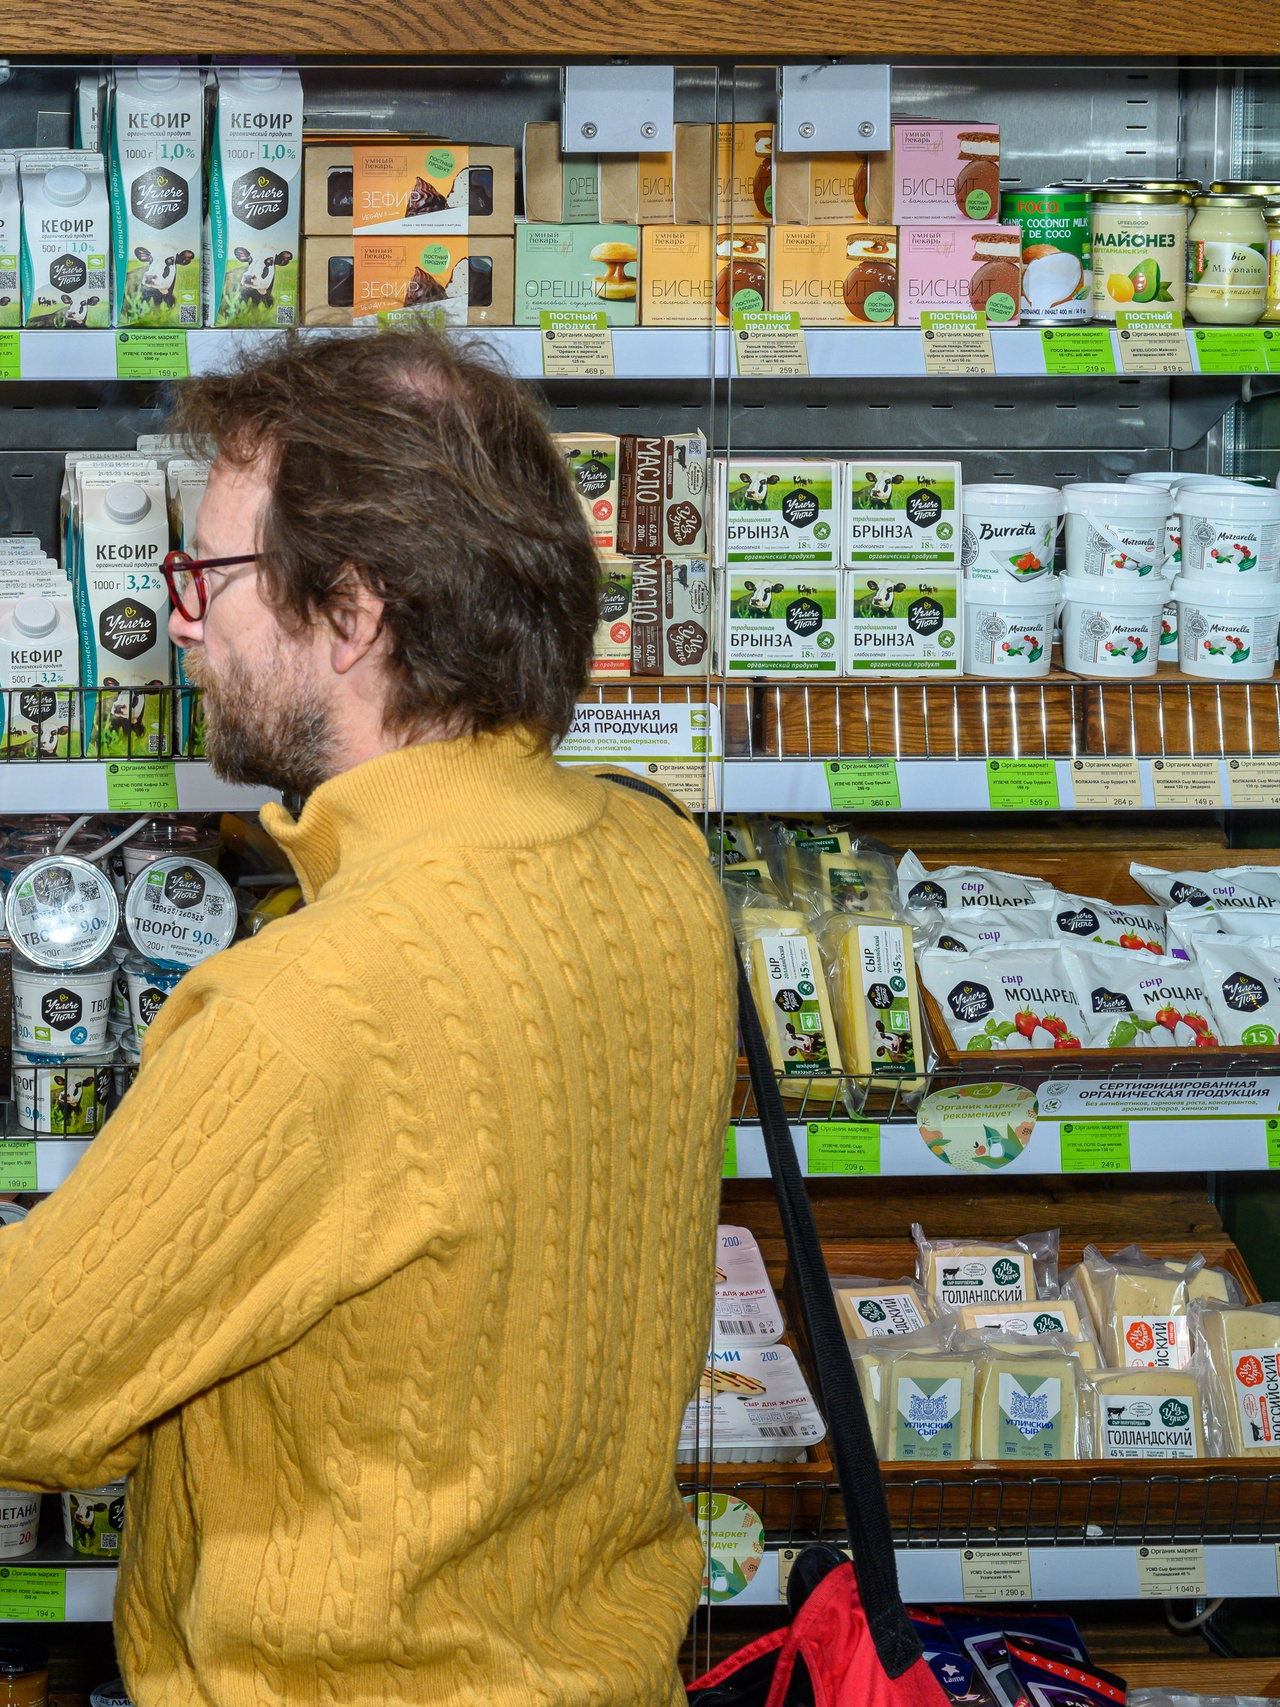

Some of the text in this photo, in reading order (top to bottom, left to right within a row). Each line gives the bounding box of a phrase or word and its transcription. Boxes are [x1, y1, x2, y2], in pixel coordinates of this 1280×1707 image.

[128, 113, 191, 129] КЕФИР
[231, 113, 293, 129] КЕФИР
[125, 149, 146, 159] 1000
[160, 143, 195, 162] 1,0%
[227, 149, 248, 159] 1000
[262, 144, 296, 160] 1,0%
[139, 183, 184, 199] Углече
[239, 184, 284, 199] Углече
[902, 178, 978, 195] БИСКВИТ
[361, 191, 420, 208] ЗЕФИР
[145, 203, 179, 219] Поле
[245, 203, 280, 219] Поле
[1018, 201, 1059, 213] FOCO
[42, 220, 93, 233] КЕФИР
[1027, 218, 1068, 228] COCONUT
[1029, 229, 1071, 238] DE COCO
[1094, 231, 1176, 248] МАЙОНЕЗ
[1231, 252, 1246, 261] bio
[361, 281, 419, 298] ЗЕФИР
[525, 280, 607, 297] ОРЕШКИ
[652, 280, 740, 297] БИСКВИТ
[782, 280, 871, 297] БИСКВИТ
[909, 280, 995, 296] БИСКВИТ
[550, 312, 598, 321] ПОСТНЫЙ
[930, 312, 977, 321] ПОСТНЫЙ
[1125, 311, 1173, 320] ПОСТНЫЙ
[932, 322, 976, 330] ПРОДУКТ
[638, 438, 661, 503] МАСЛО
[727, 526, 790, 539] БРЫНЗА
[852, 525, 913, 538] БРЫНЗА
[979, 522, 1036, 540] Burrata
[1217, 532, 1257, 541] Mozzarella
[1121, 537, 1154, 546] Mozzarella
[96, 544, 158, 560] КЕФИР
[127, 575, 160, 591] 3,2%
[633, 560, 658, 624] МАСЛО
[105, 615, 151, 629] Углече
[1008, 625, 1044, 634] Mozzarella
[1112, 625, 1149, 634] Mozzarella
[1210, 625, 1250, 634] Mozzarella
[113, 633, 147, 650] Поле
[731, 633, 792, 647] БРЫНЗА
[854, 633, 914, 647] БРЫНЗА
[11, 650, 63, 664] КЕФИР
[41, 672, 63, 683] 3,2%
[594, 722, 678, 736] ПРОДУКЦИЯ
[871, 798, 883, 806] 360
[961, 882, 984, 893] сыр
[134, 917, 220, 947] ТВОРОГ 9,0%
[865, 948, 876, 973] СЫР
[770, 957, 782, 980] СЫР
[1001, 975, 1023, 985] сыр
[1139, 977, 1162, 989] сыр
[1250, 1031, 1268, 1044] 15
[1099, 1080, 1257, 1091] СЕРТИФИЦИРОВАННАЯ
[1079, 1088, 1269, 1100] ОРГАНИЧЕСКАЯ ПРОДУКЦИЯ
[935, 1102, 1021, 1113] Органик маркет
[943, 1111, 1013, 1121] рекомендует
[722, 1236, 739, 1247] 200
[942, 1286, 1022, 1303] ГОЛЛАНДСКИЙ
[760, 1351, 778, 1362] 200
[778, 1397, 806, 1406] ЖАРКИ
[904, 1421, 953, 1430] УГЛИЧСКИЙ
[1005, 1419, 1053, 1430] УГЛИЧСКИЙ
[1019, 1427, 1039, 1435] СЫР
[1108, 1428, 1192, 1446] ГОЛЛАНДСКИЙ
